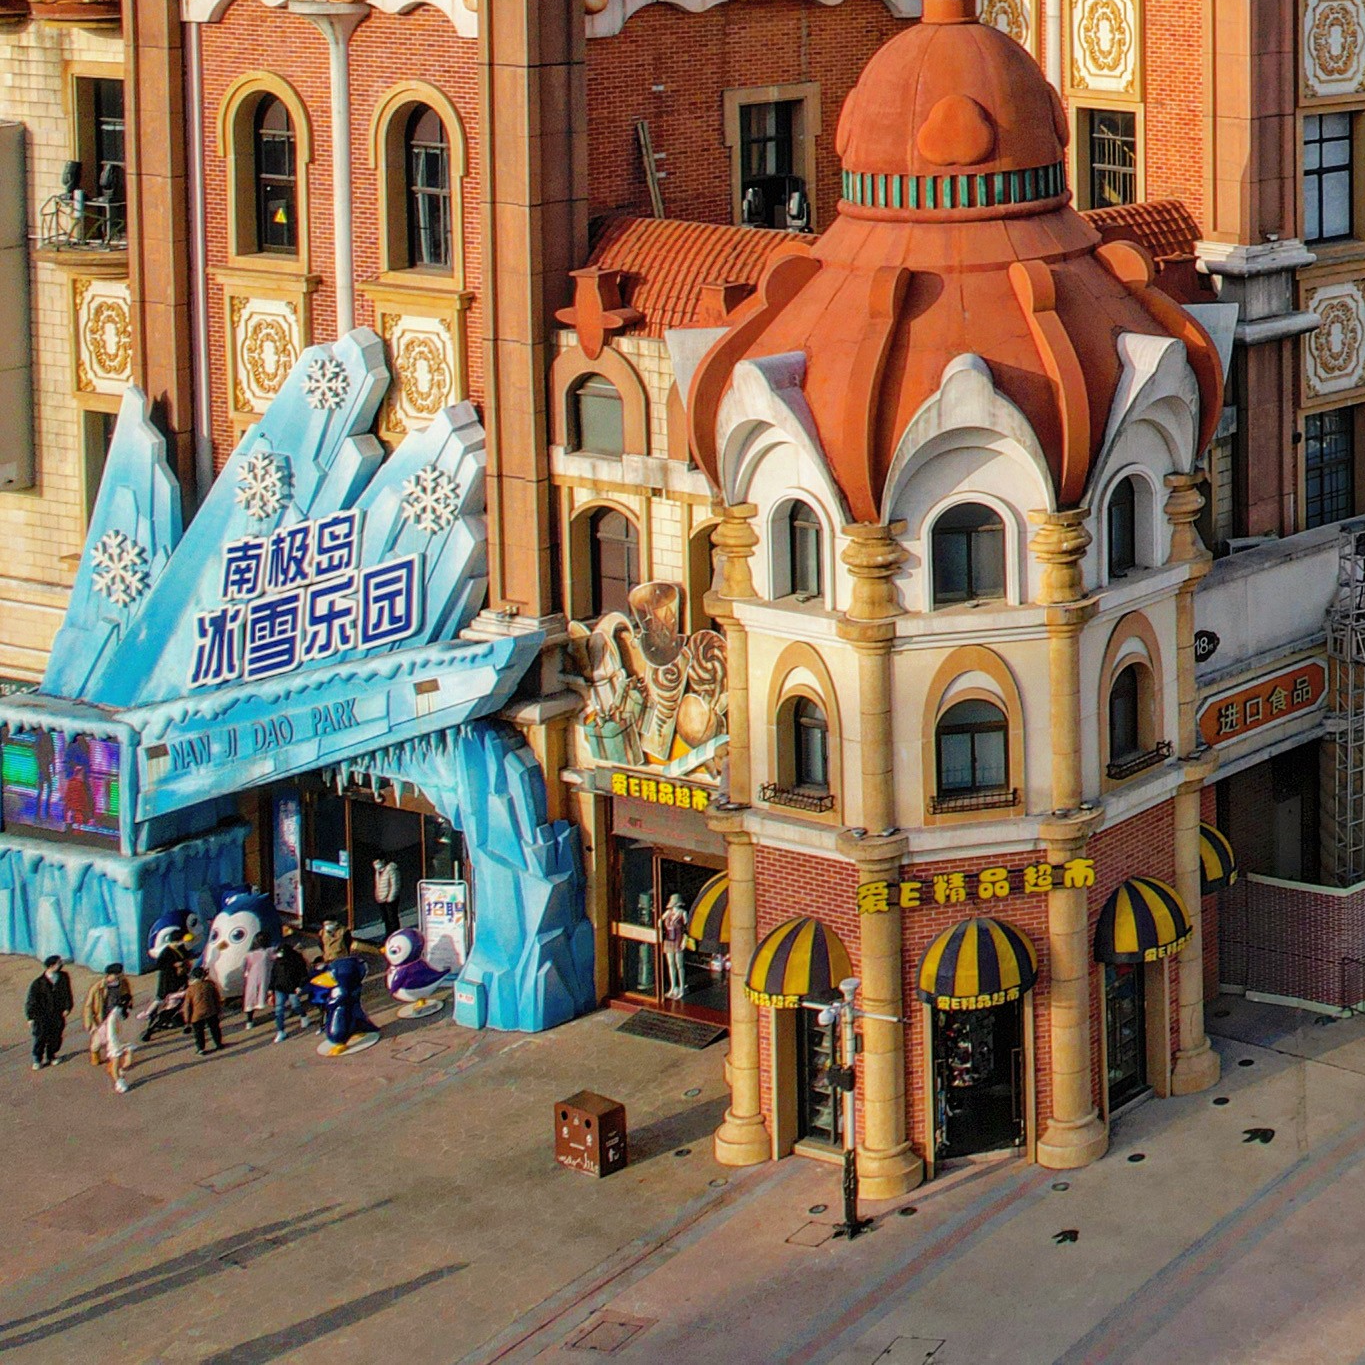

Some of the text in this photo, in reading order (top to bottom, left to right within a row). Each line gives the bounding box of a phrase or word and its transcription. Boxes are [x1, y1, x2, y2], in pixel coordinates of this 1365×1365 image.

[221, 511, 356, 601] 南极岛
[188, 556, 421, 686] 冰雪乐园
[169, 697, 360, 771] NAN JI DAO PARK
[1219, 675, 1313, 735] 进口食品
[611, 772, 710, 812] 爱E精品超市
[857, 858, 1097, 915] 爱E精品超市
[937, 986, 1020, 1011] 爱E精品超市
